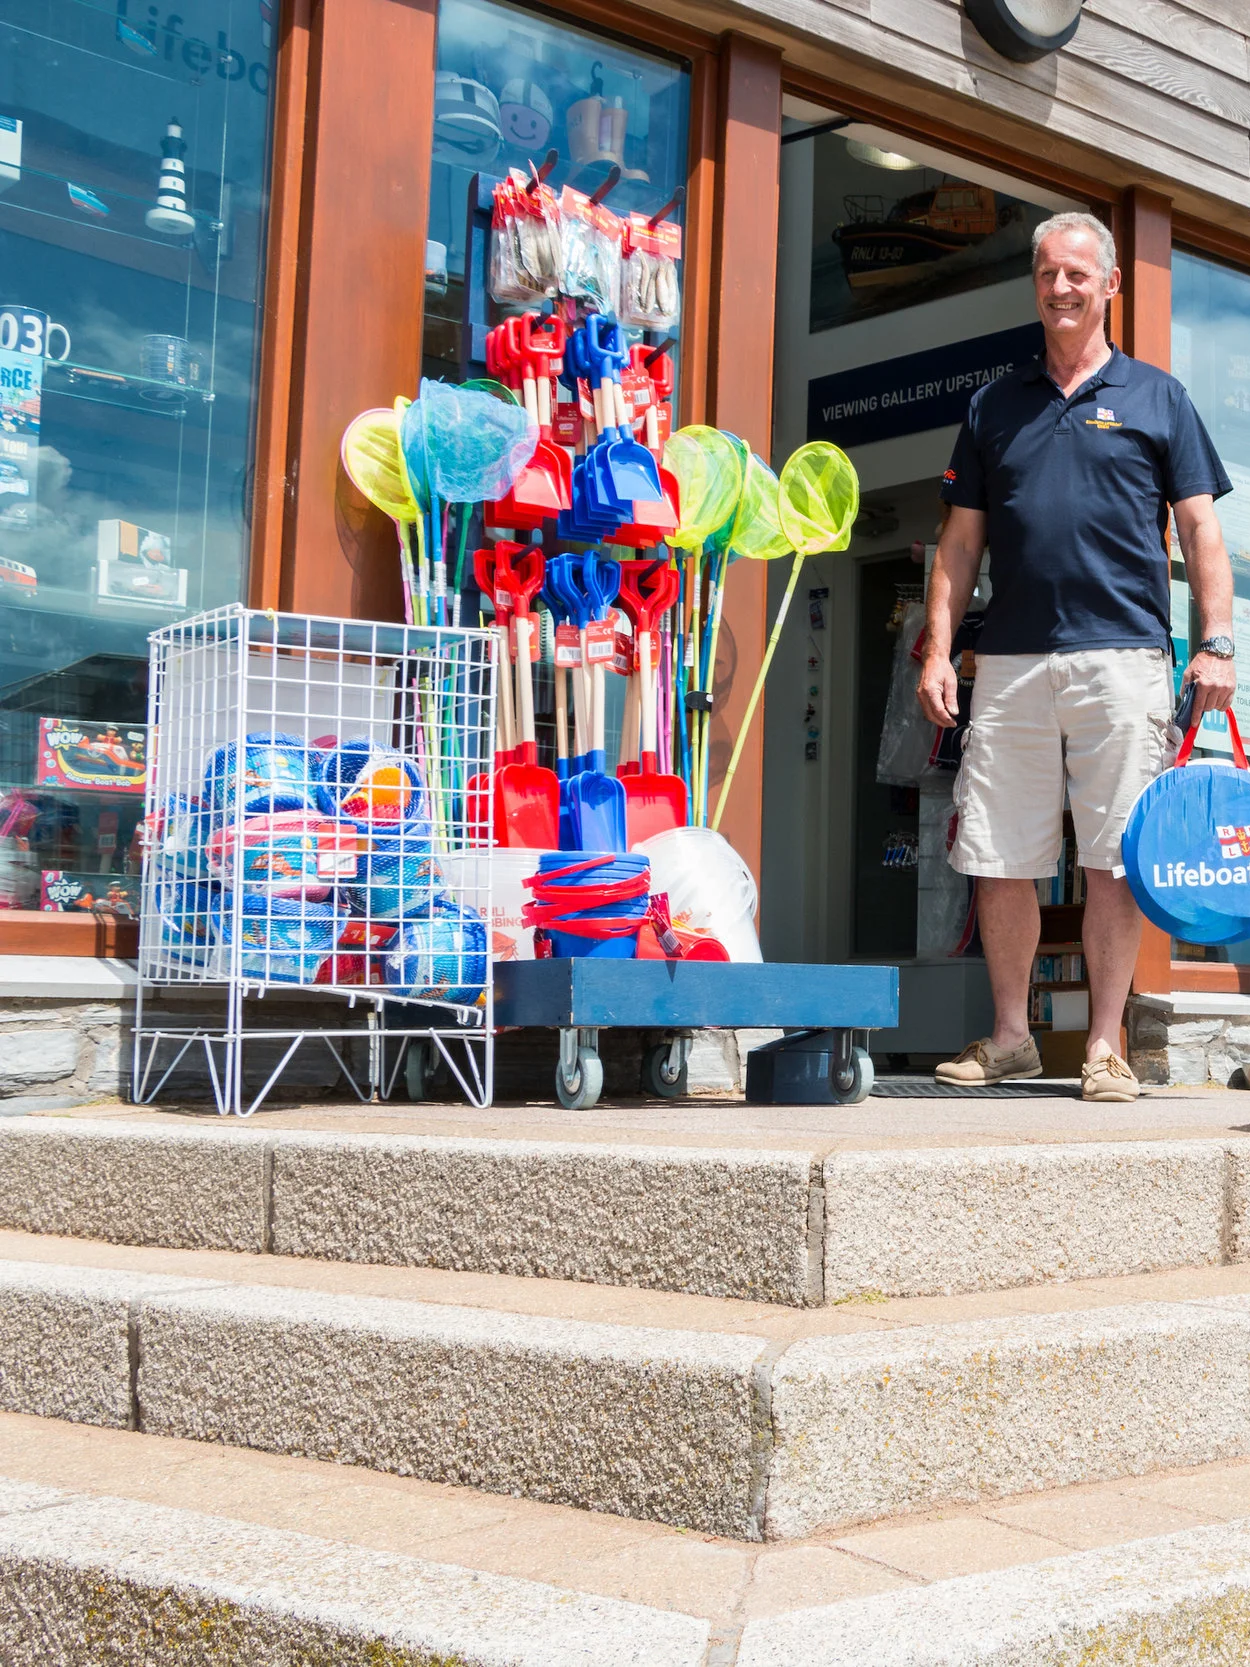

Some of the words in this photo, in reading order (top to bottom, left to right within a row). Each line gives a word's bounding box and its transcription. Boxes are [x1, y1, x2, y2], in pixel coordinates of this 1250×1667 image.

[822, 396, 878, 422] VIEWING
[881, 380, 944, 408] GALLERY
[46, 732, 83, 747] WOW
[47, 885, 82, 900] WOW
[480, 906, 505, 917] RLI
